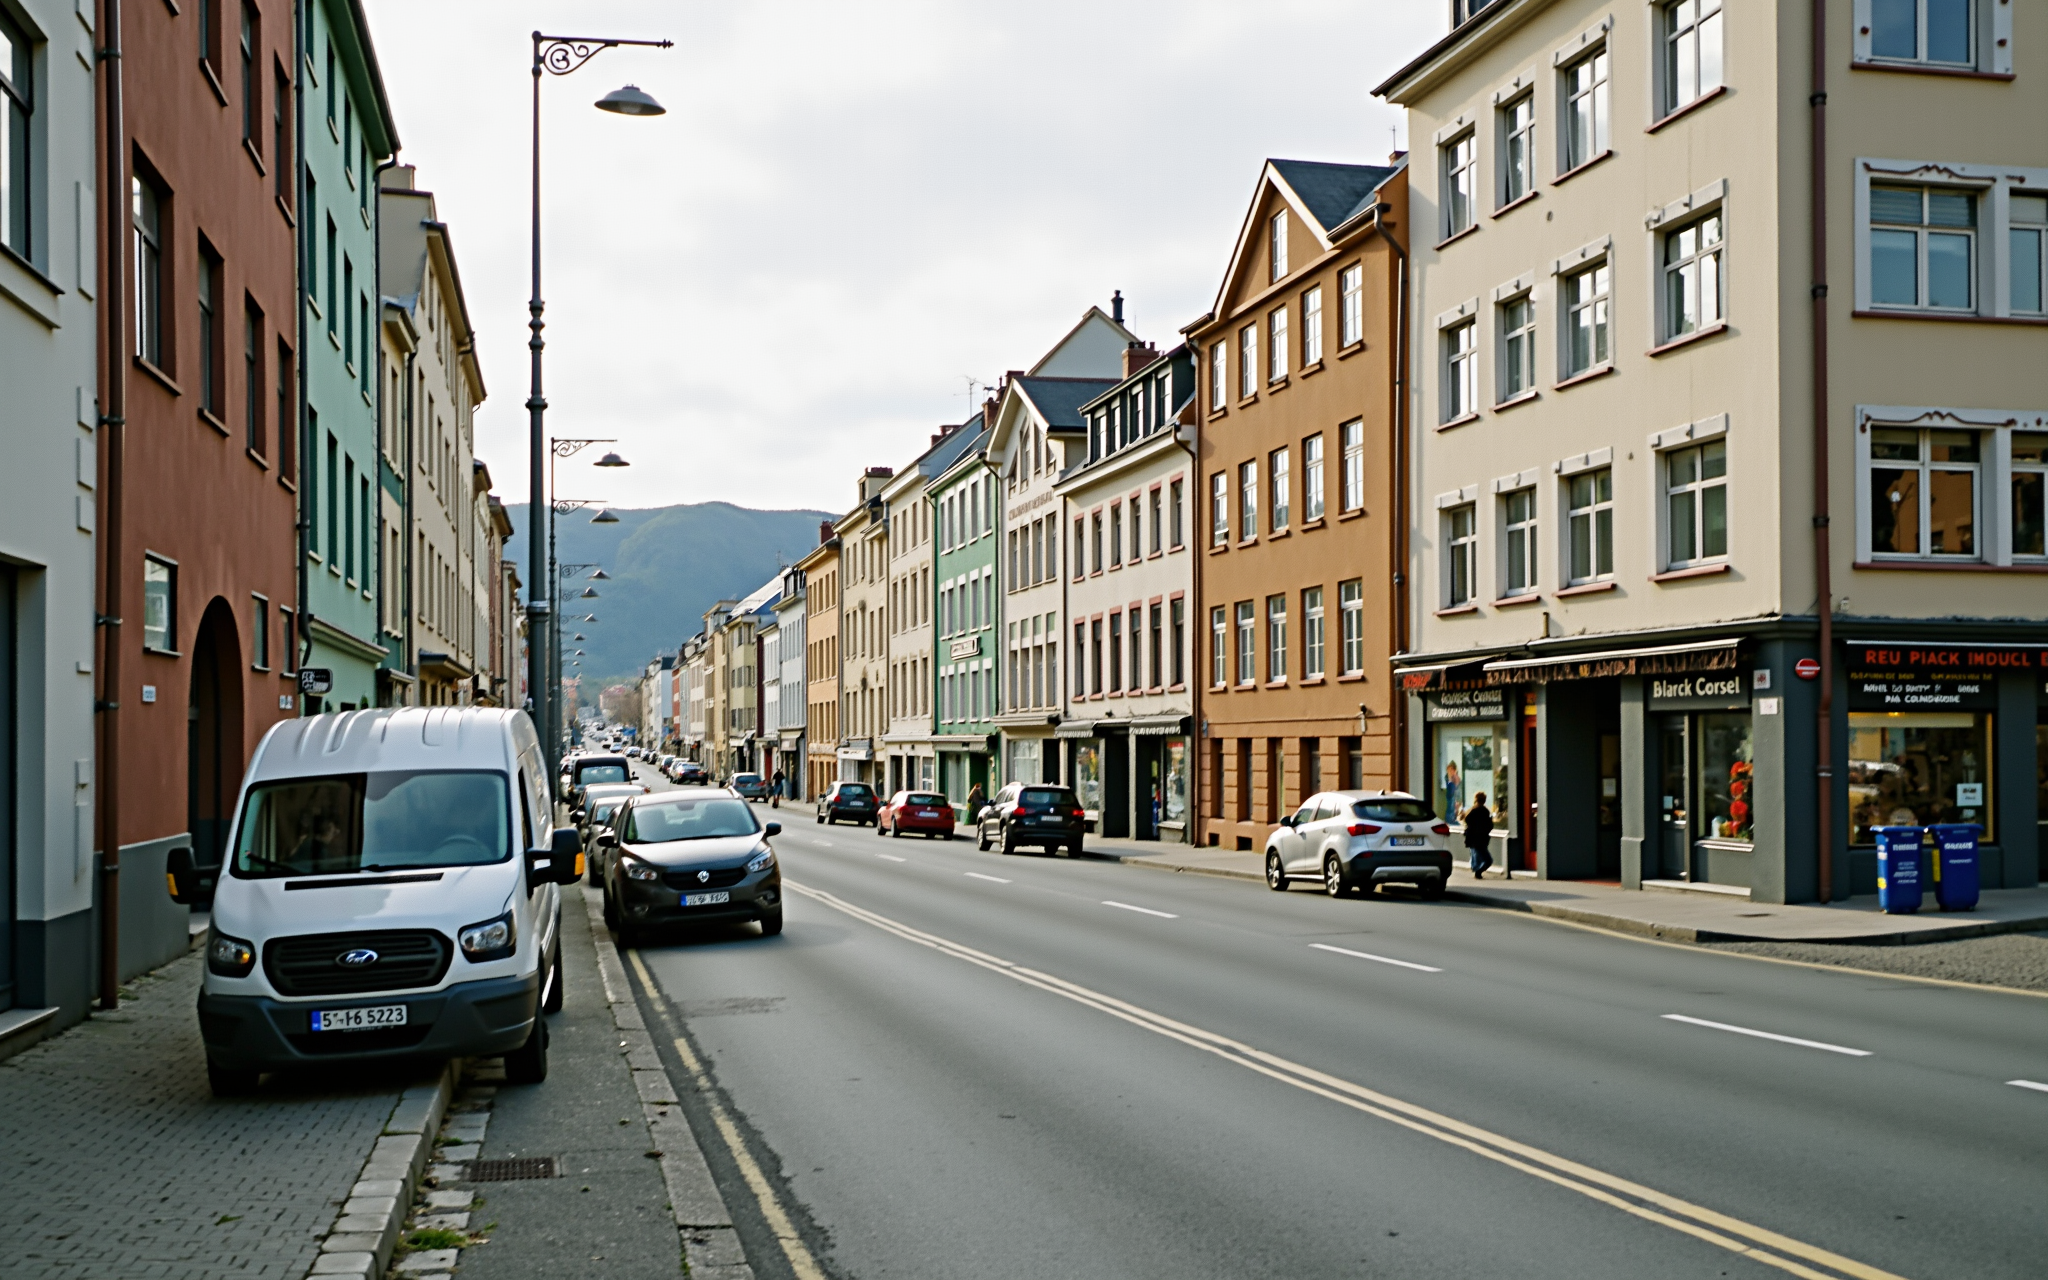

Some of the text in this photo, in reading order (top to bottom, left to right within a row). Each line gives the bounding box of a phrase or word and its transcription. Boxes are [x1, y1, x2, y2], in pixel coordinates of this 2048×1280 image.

[1865, 650, 1901, 665] REU
[1652, 676, 1740, 699] Blarck Corsel
[366, 1007, 404, 1024] 5223
